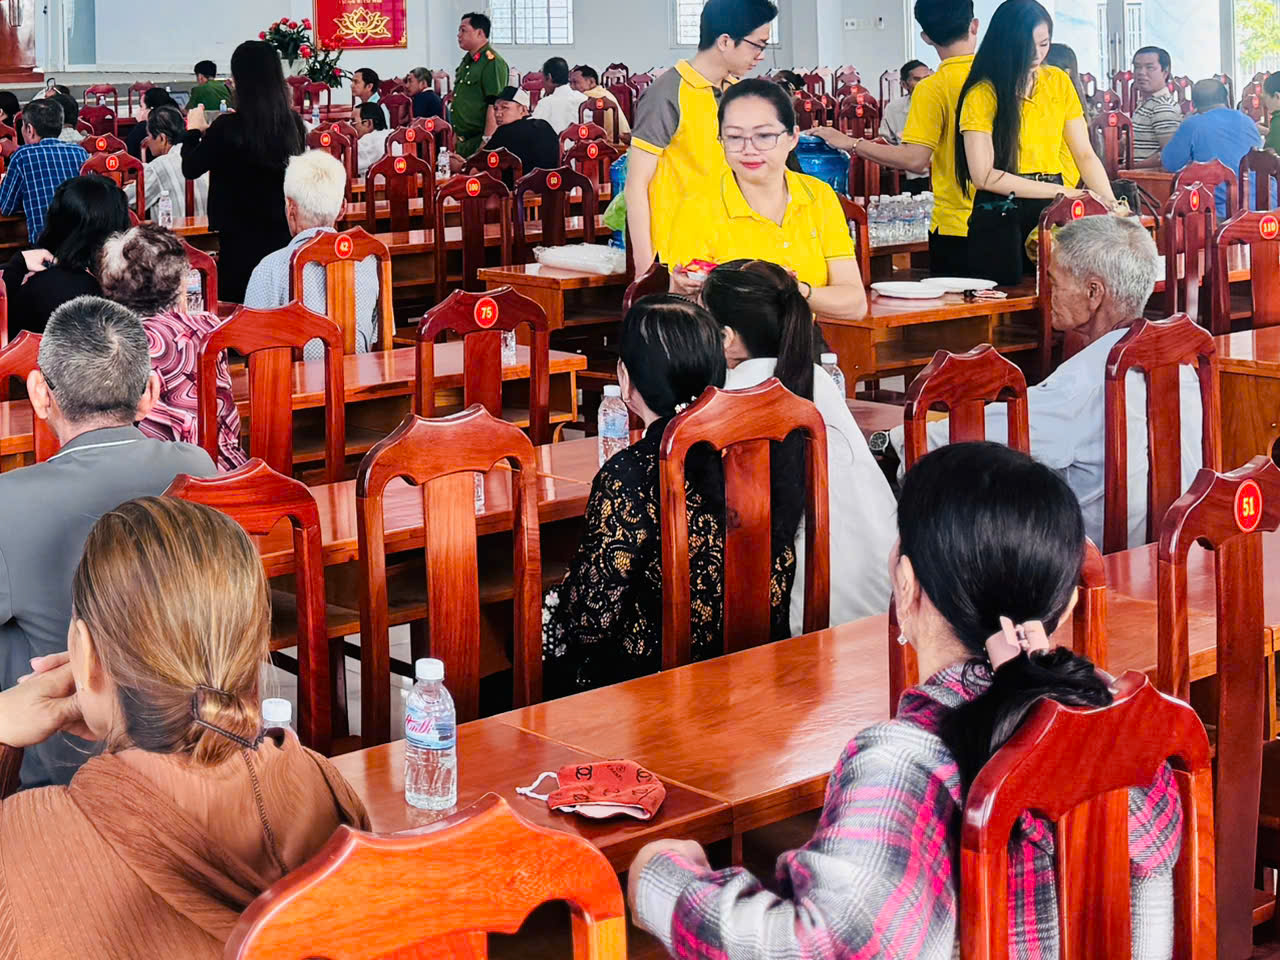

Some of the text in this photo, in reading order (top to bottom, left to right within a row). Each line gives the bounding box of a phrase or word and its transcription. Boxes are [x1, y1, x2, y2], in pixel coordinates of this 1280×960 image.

[468, 183, 480, 192] 100
[1262, 222, 1276, 234] 110
[340, 240, 350, 252] 42
[480, 305, 493, 319] 75
[1242, 496, 1257, 517] 51
